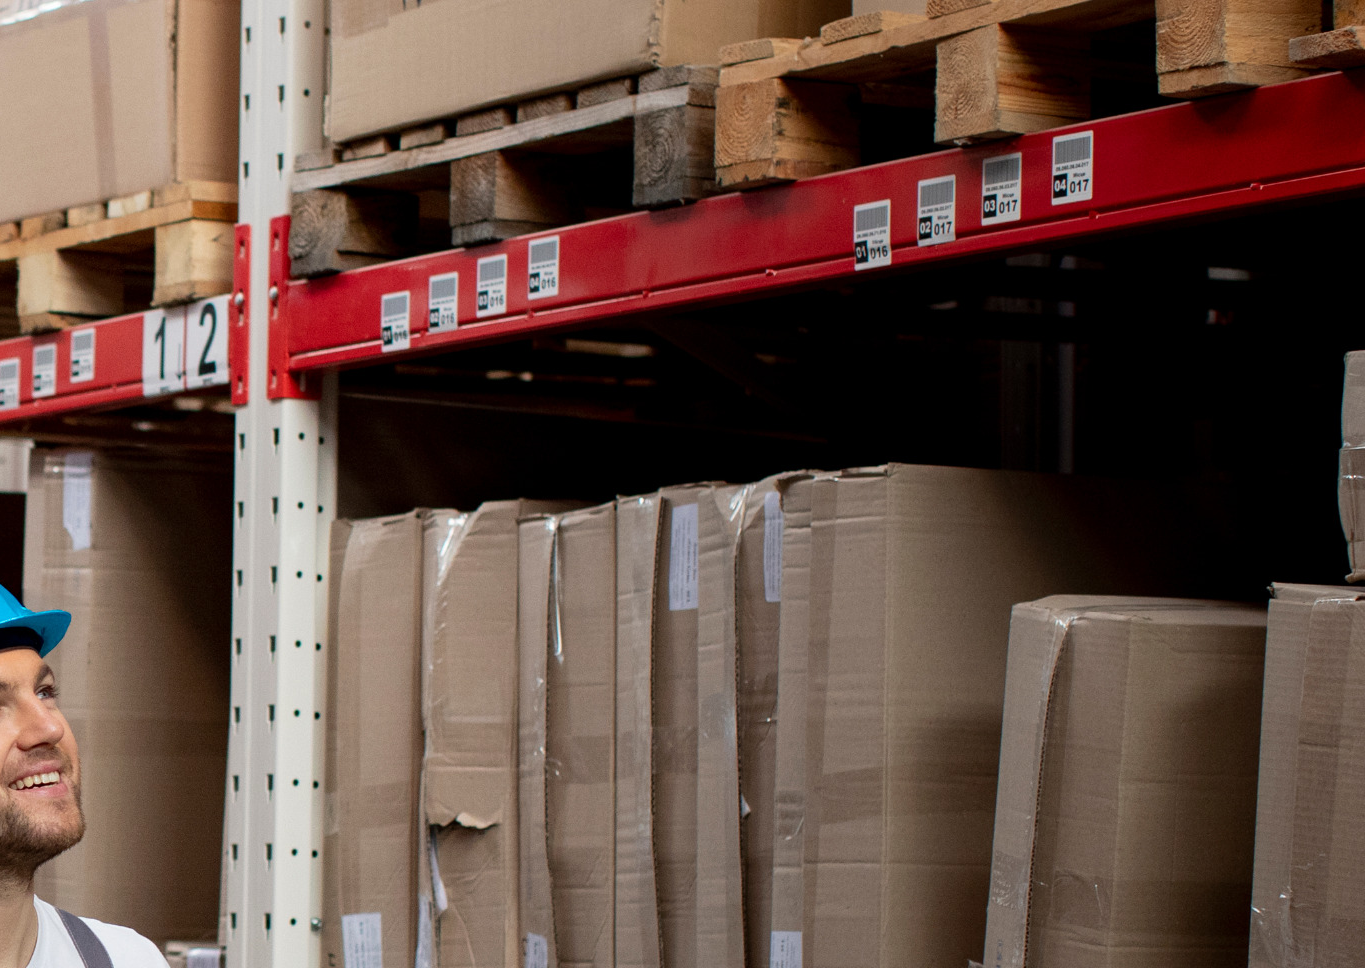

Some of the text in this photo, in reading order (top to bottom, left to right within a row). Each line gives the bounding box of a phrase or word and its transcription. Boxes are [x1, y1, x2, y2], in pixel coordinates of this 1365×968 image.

[1054, 178, 1090, 194] 04 017
[984, 199, 1018, 214] 03 017
[919, 221, 953, 236] 02 017
[856, 245, 888, 259] 01 016
[541, 276, 557, 289] 016
[154, 316, 166, 380] 1
[198, 302, 217, 376] 2
